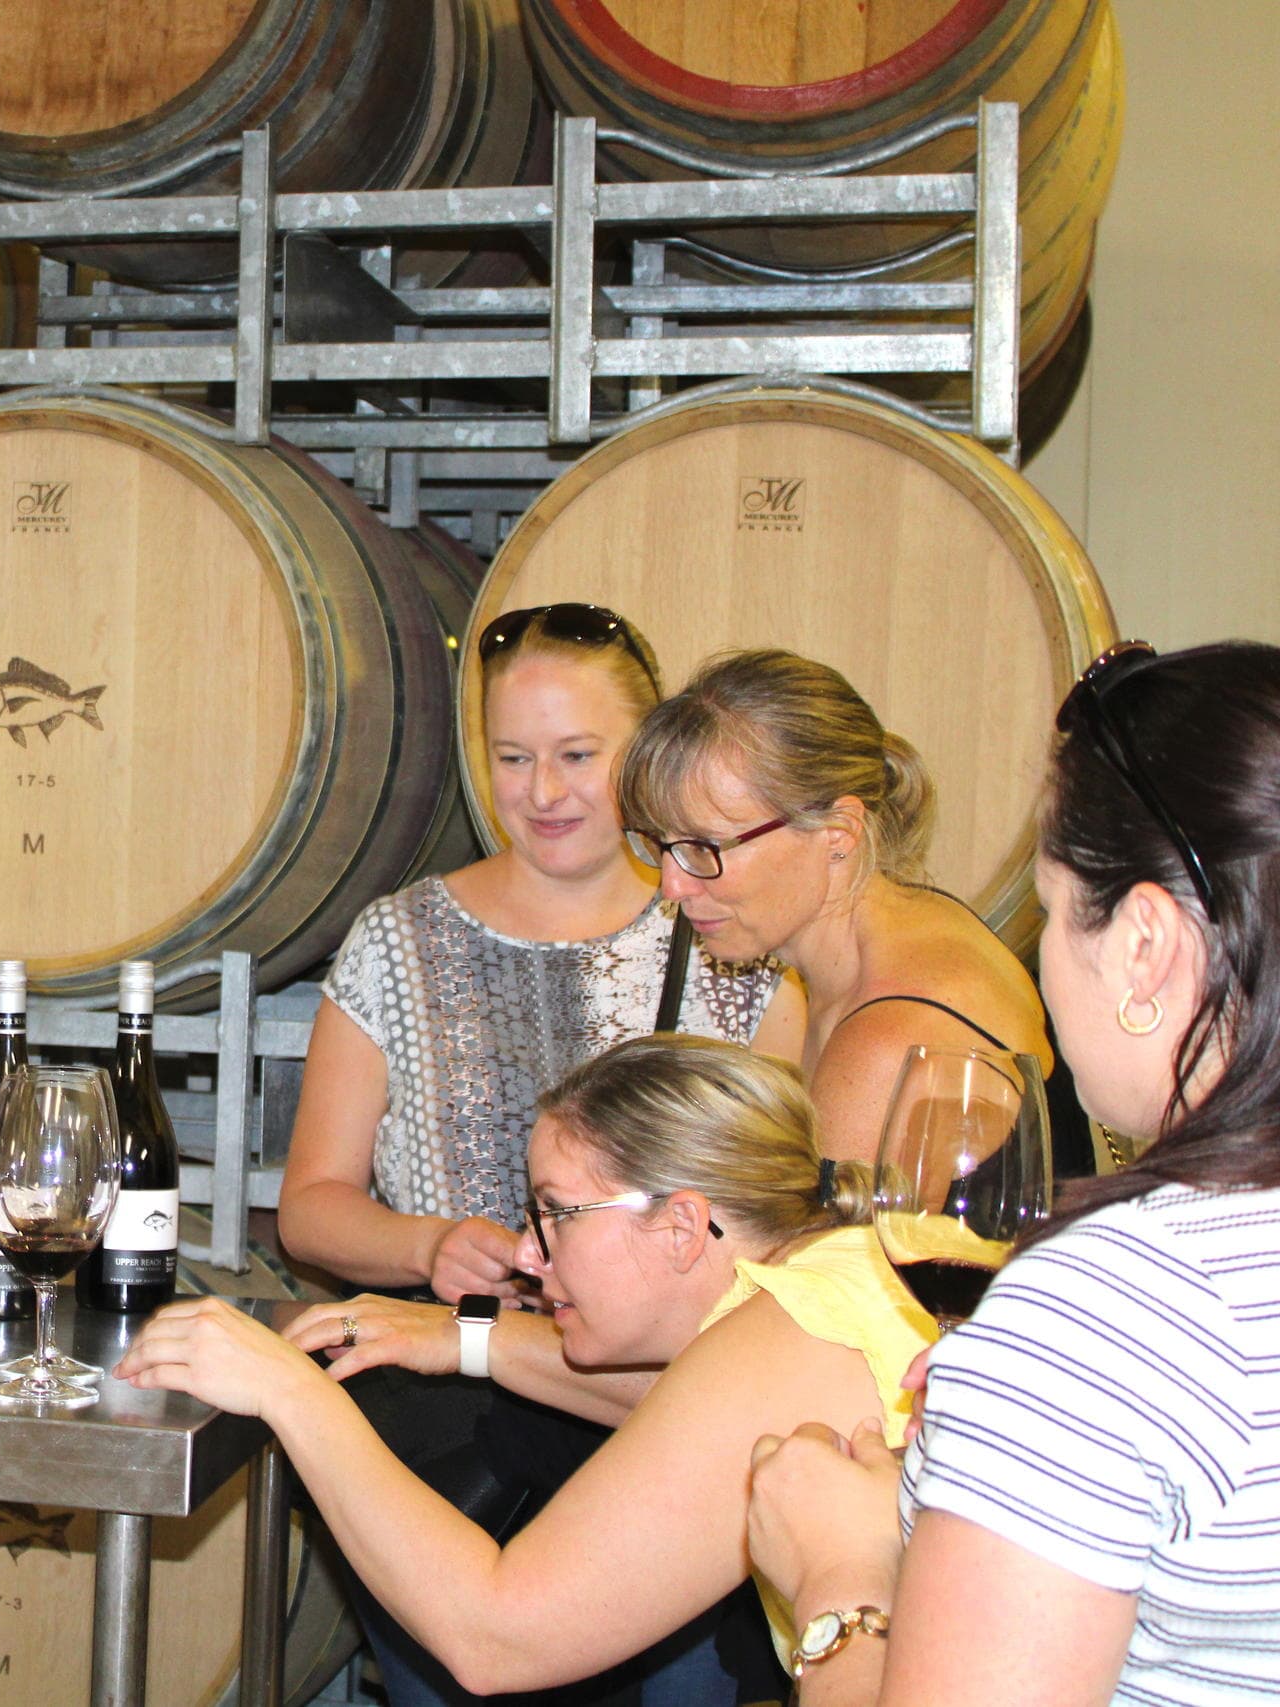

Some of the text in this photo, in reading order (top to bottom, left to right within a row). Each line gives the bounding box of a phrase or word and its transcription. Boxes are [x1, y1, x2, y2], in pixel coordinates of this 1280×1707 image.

[16, 774, 56, 788] 17-5
[23, 833, 45, 854] M
[115, 1257, 139, 1267] UPPER
